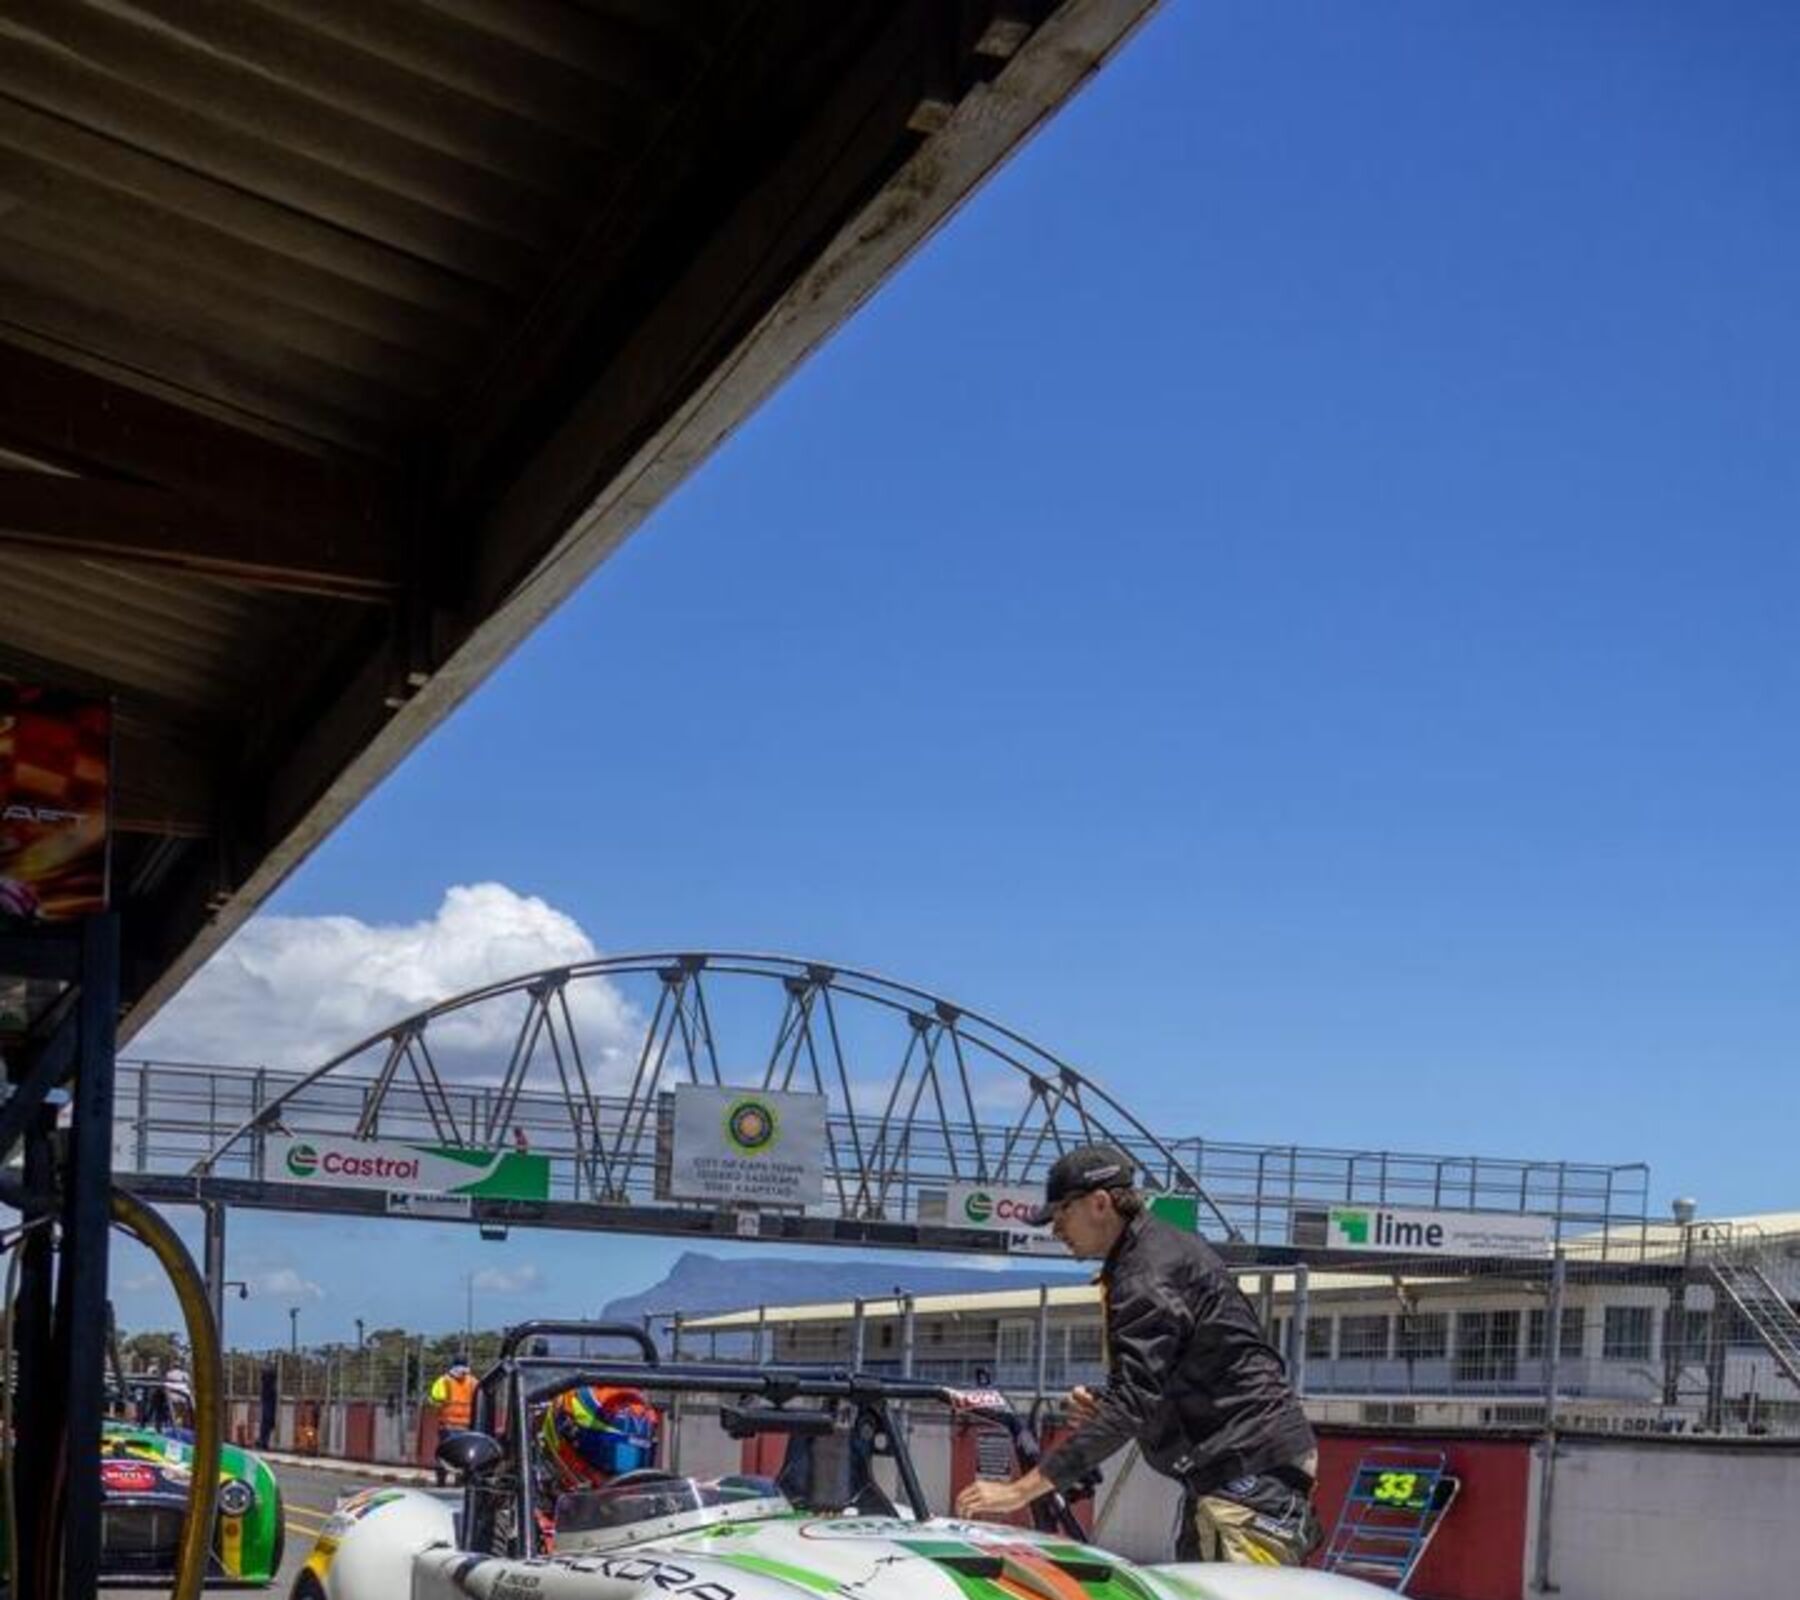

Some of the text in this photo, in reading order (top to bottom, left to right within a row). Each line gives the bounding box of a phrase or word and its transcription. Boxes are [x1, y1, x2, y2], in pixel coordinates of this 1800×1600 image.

[322, 1151, 419, 1179] Castrol
[1374, 1213, 1443, 1247] lime
[1374, 1473, 1417, 1499] 33
